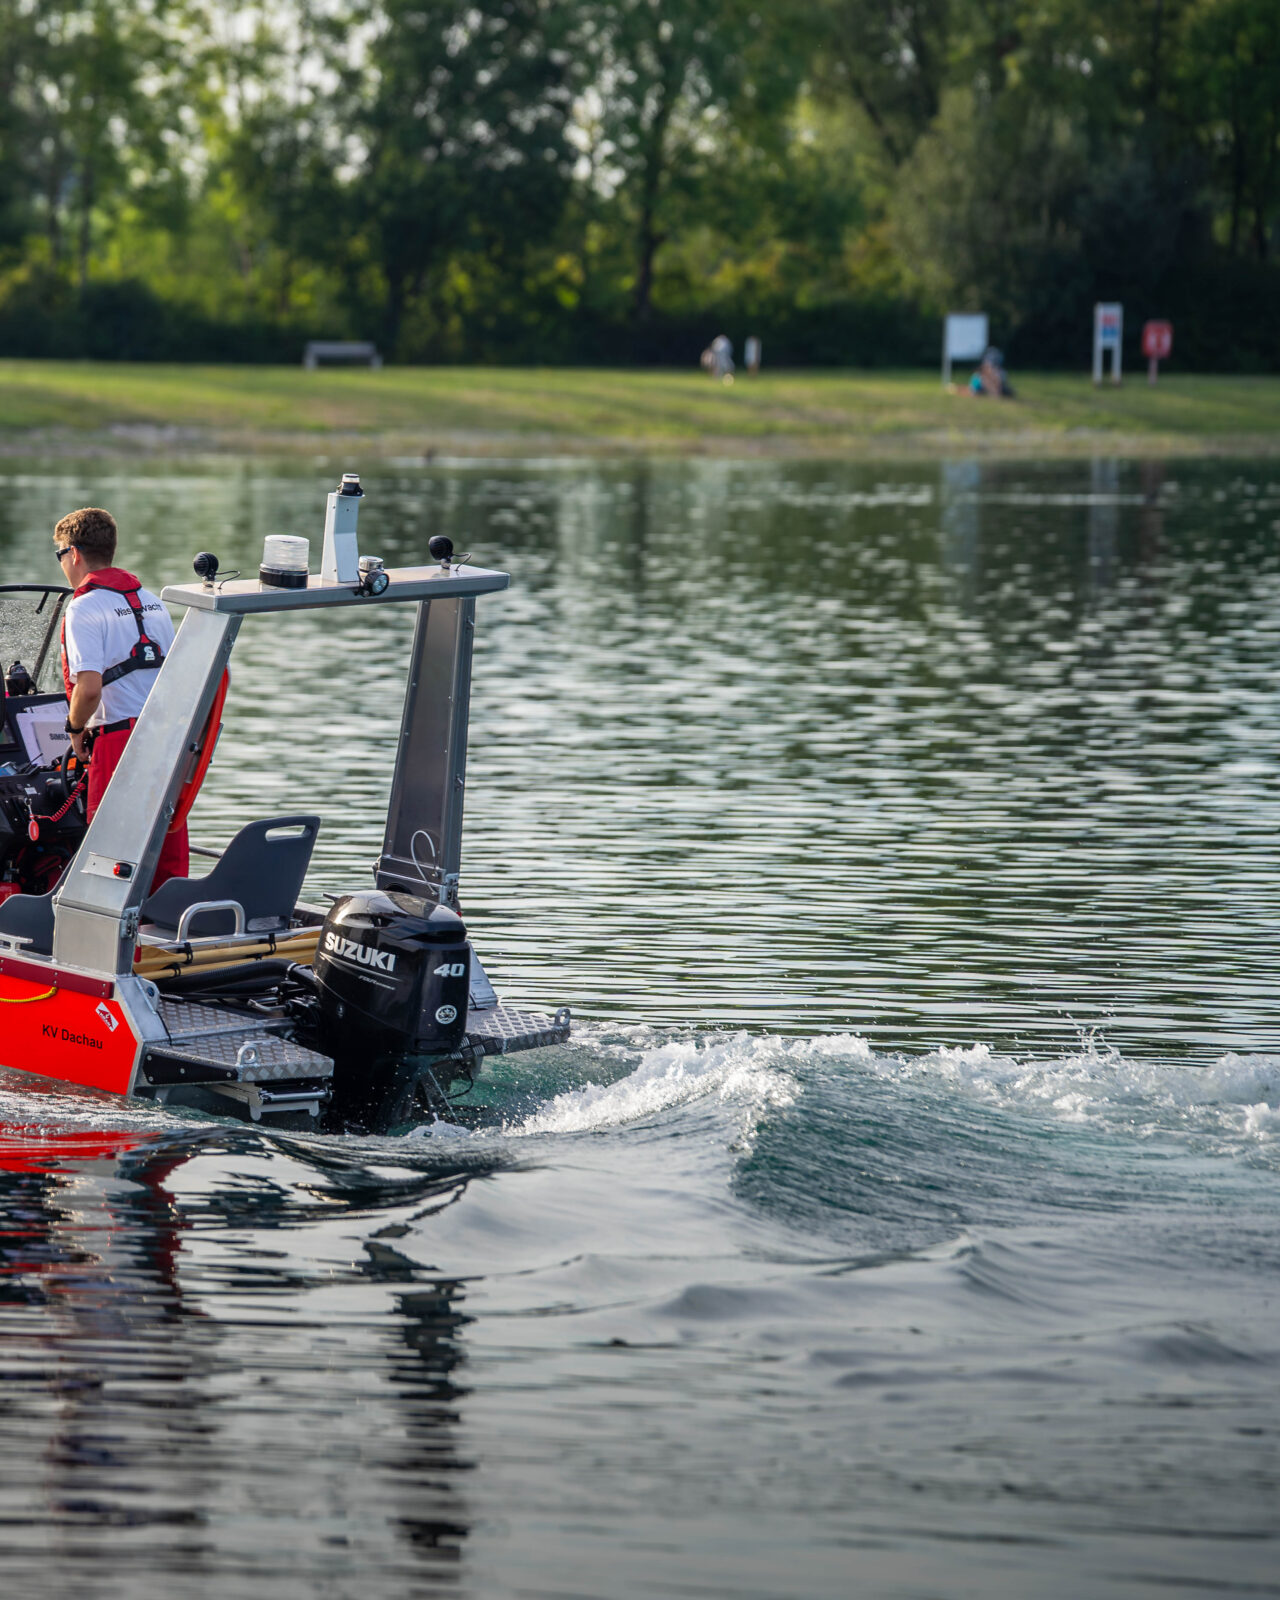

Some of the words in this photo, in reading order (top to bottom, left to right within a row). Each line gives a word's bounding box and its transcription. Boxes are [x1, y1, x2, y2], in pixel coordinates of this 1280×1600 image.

[324, 932, 396, 972] SUZUKI
[433, 963, 466, 978] 40
[42, 1023, 59, 1039] KV
[61, 1027, 104, 1050] Dachau
